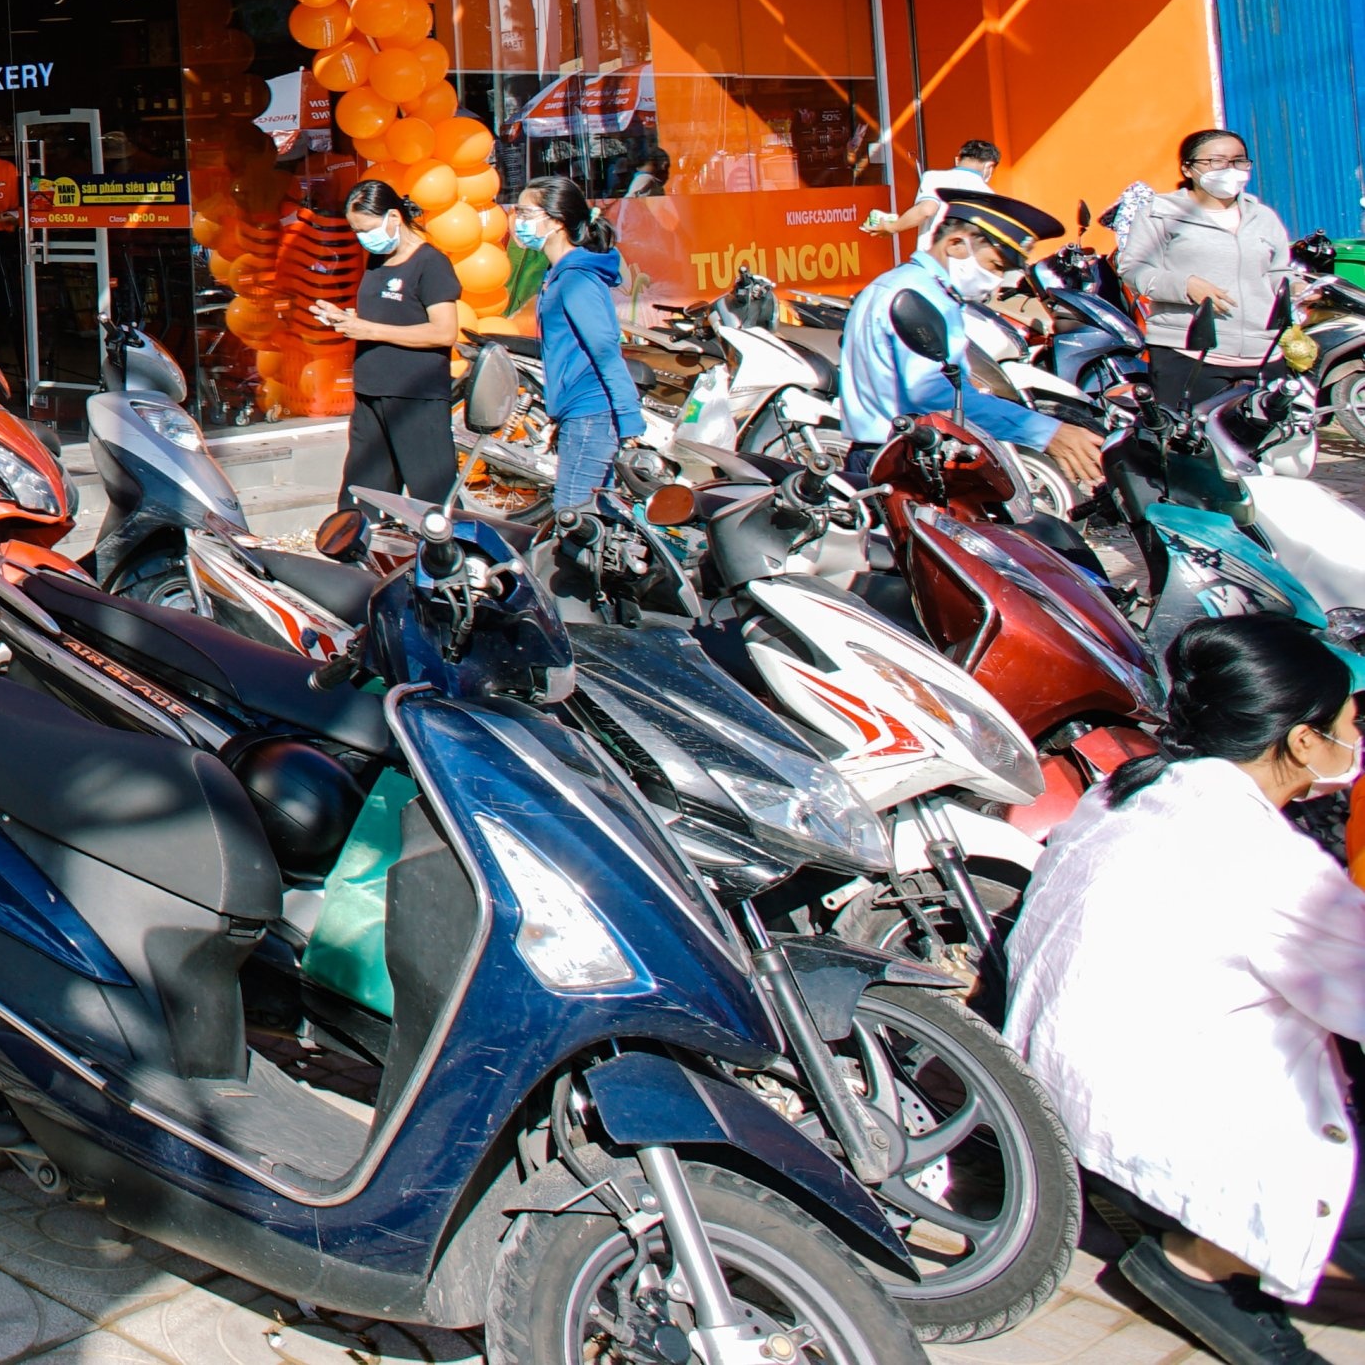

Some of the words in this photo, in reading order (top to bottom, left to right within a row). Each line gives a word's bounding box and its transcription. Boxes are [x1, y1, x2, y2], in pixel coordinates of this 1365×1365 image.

[48, 213, 75, 223] 06:30
[690, 242, 768, 291] TƯƠI
[775, 241, 861, 284] NGON
